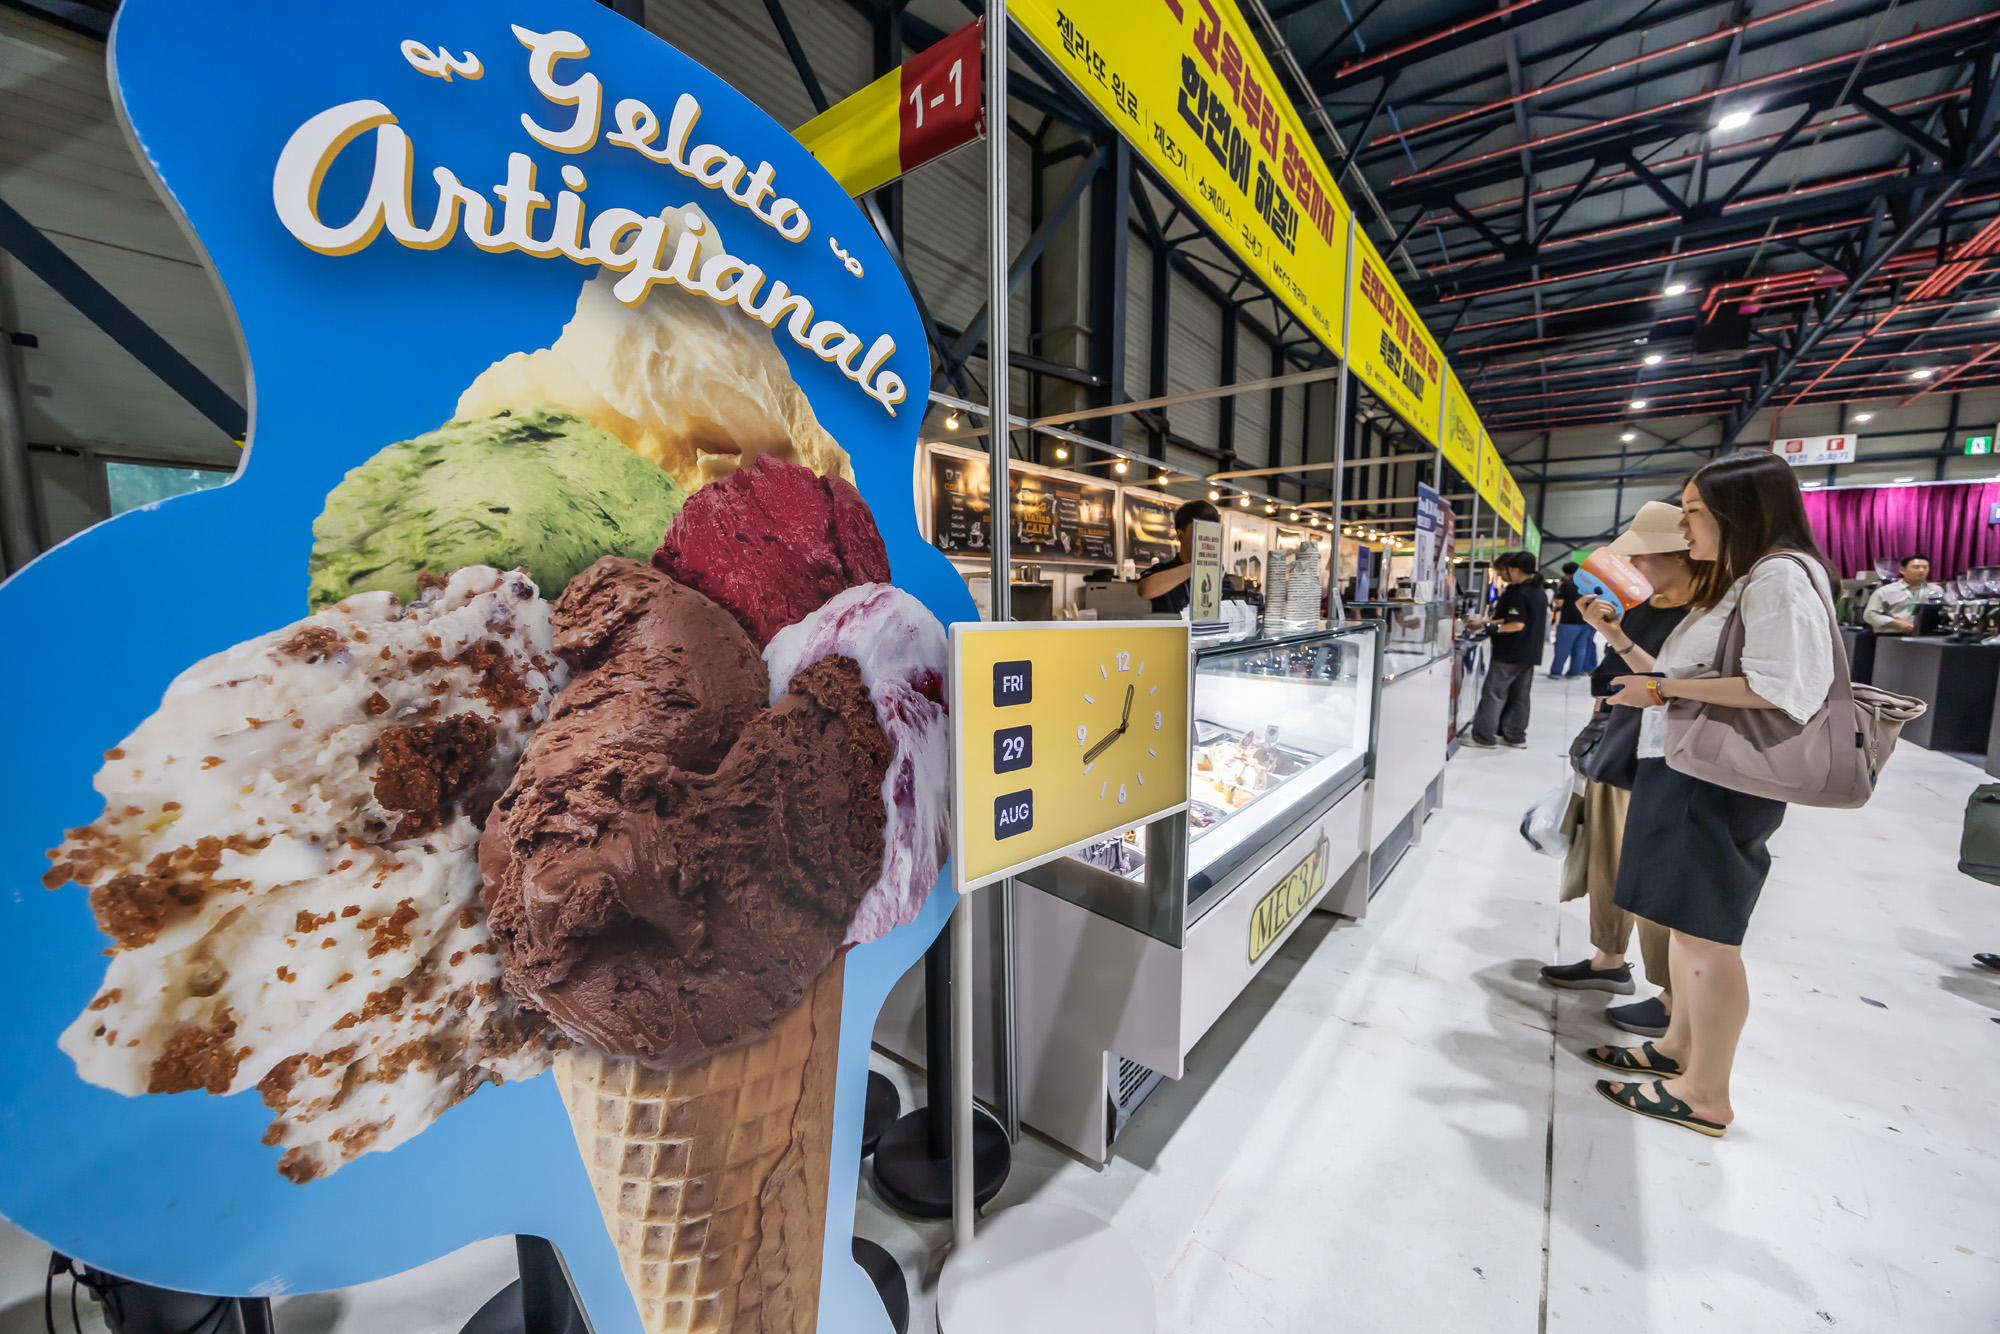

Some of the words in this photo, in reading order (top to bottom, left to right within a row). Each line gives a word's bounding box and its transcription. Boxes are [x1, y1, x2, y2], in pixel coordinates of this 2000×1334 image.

[909, 58, 962, 128] 1-1
[1056, 8, 1109, 90] 젤라또
[1111, 73, 1141, 126] 원료
[1153, 121, 1188, 181] 제조기
[511, 23, 811, 243] Gelato
[1193, 0, 1281, 164] 교육부터
[1282, 132, 1335, 248] 창업까지
[1177, 53, 1252, 197] 한번에
[1255, 160, 1299, 256] 해결!!
[272, 99, 907, 418] Artigianale
[1026, 522, 1050, 535] CAFE
[1116, 651, 1130, 672] 12
[1003, 674, 1023, 693] FRI
[1153, 711, 1162, 730] 3
[1077, 725, 1087, 746] 9
[1002, 736, 1025, 761] 29
[1118, 784, 1127, 803] 6
[999, 803, 1029, 827] AUG
[1256, 862, 1309, 953] MEC3
